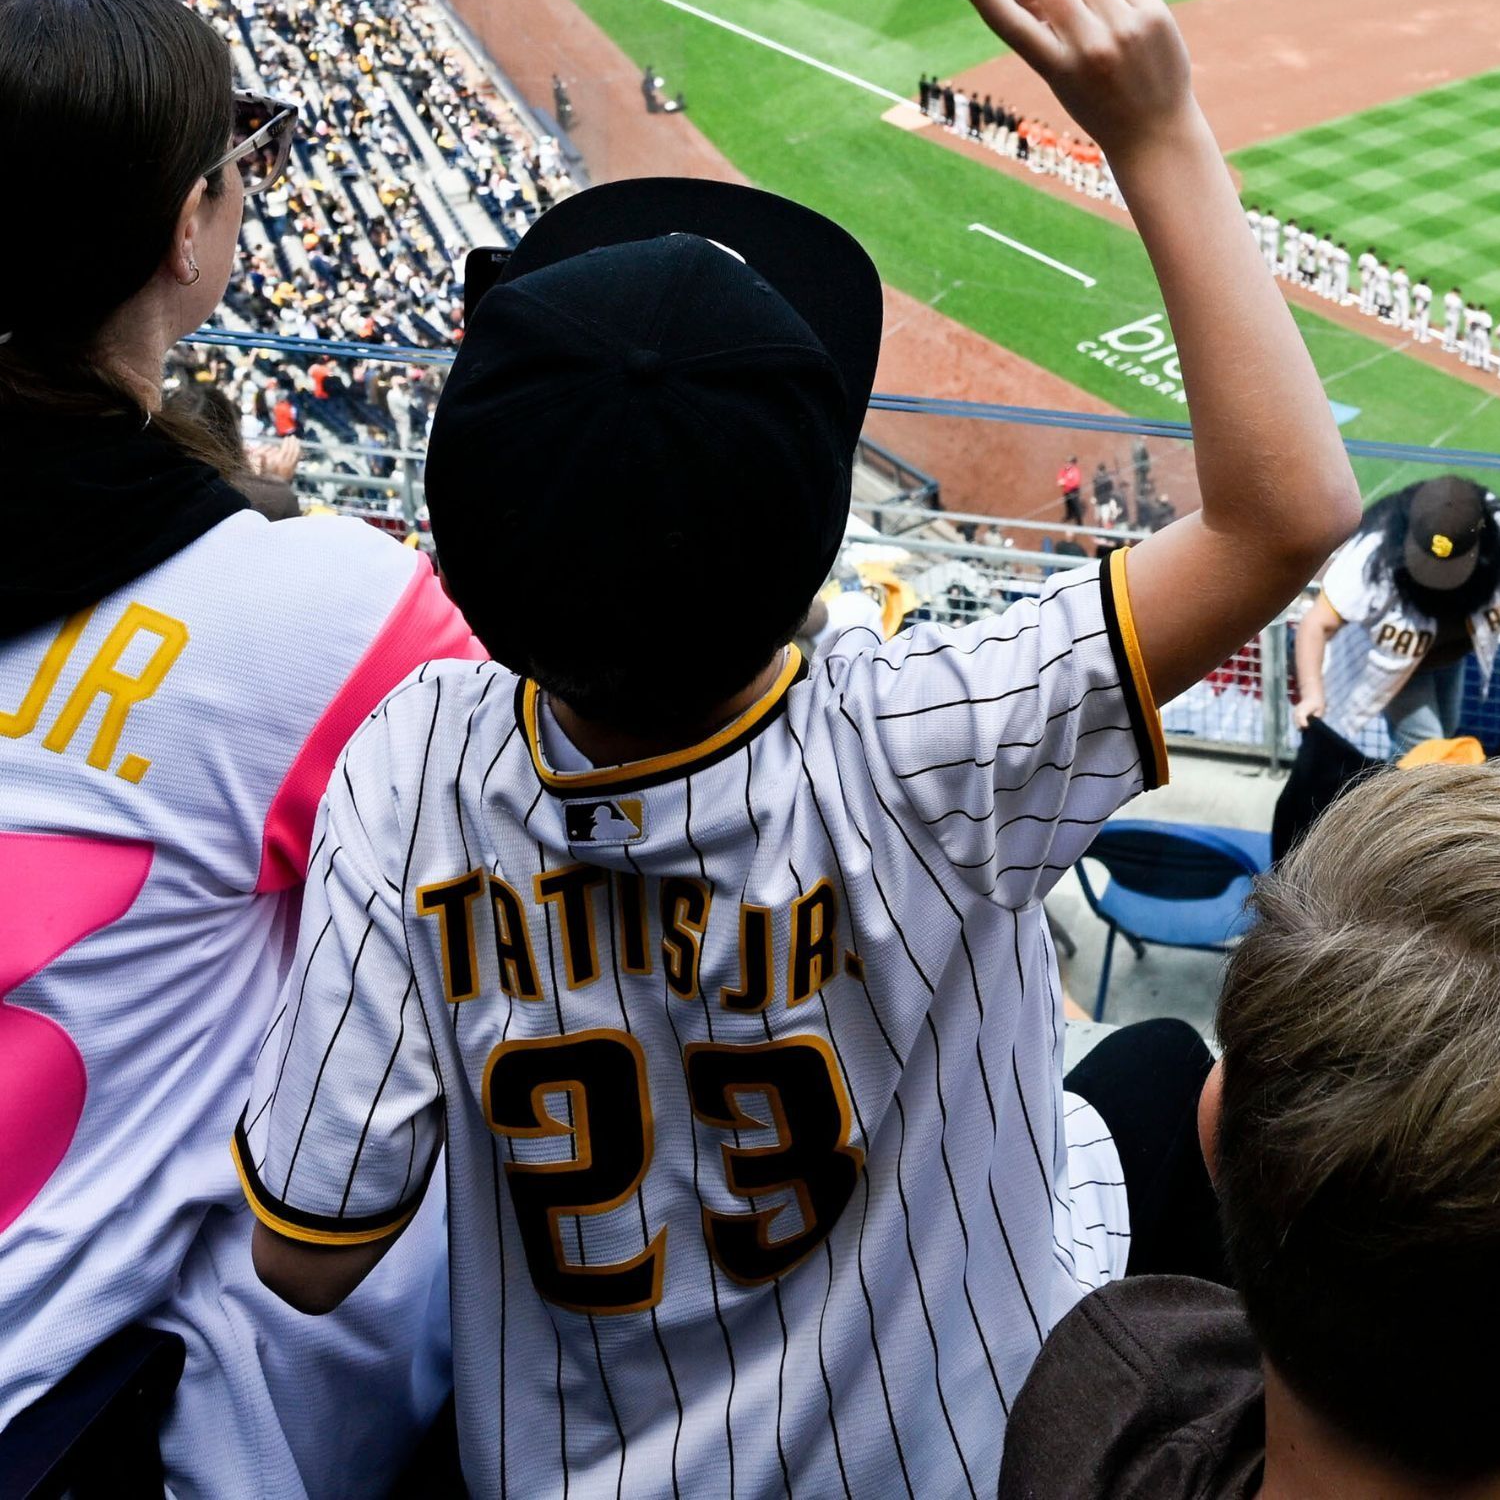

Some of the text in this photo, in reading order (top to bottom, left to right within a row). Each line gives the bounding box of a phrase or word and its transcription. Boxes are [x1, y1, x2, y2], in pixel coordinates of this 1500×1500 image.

[0, 601, 190, 785] JR.
[416, 864, 866, 1014] TATIS JR.
[482, 1027, 867, 1315] 23
